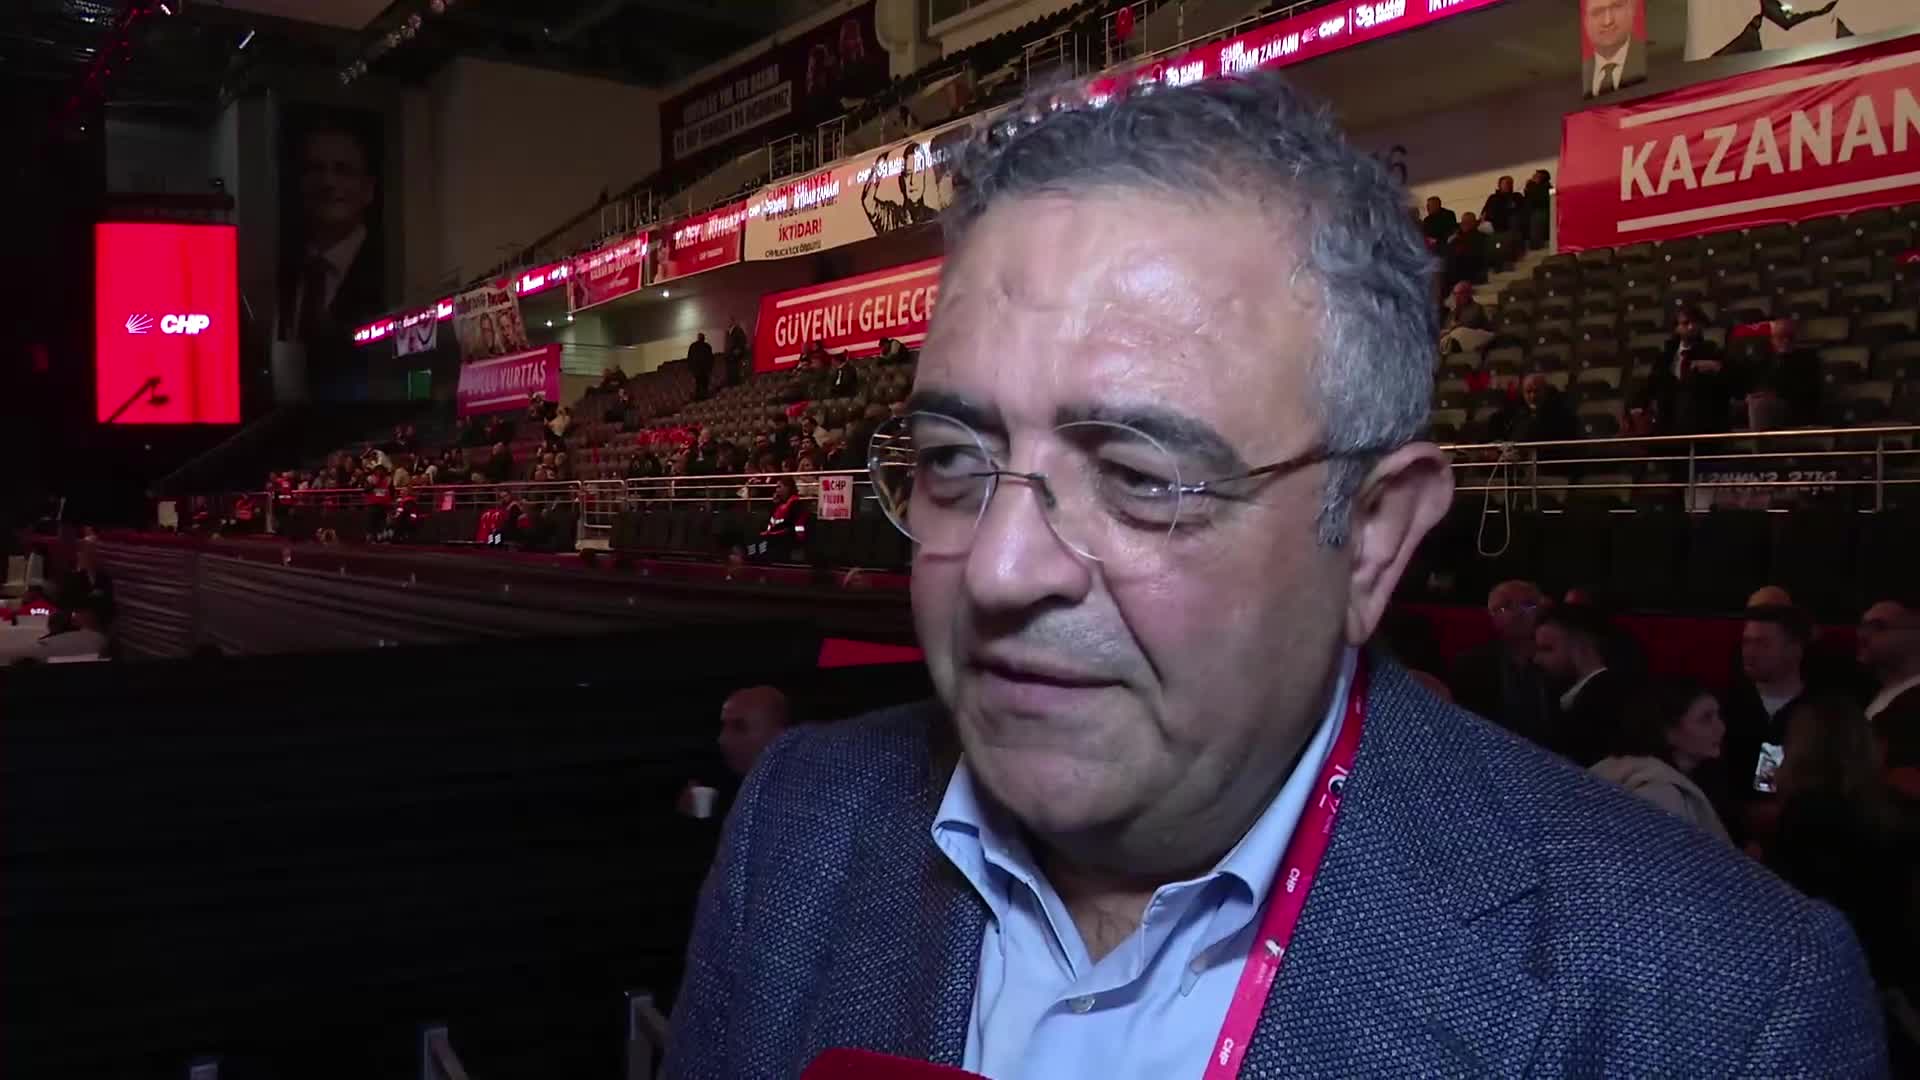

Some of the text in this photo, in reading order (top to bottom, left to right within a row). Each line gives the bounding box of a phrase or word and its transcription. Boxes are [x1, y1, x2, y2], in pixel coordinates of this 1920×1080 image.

[1260, 32, 1299, 64] ZAMANI
[1620, 87, 1920, 202] KAZANAN
[778, 217, 823, 242] İKTİDAR!
[160, 314, 210, 334] CHP
[775, 304, 852, 347] GÜVENLİ
[1285, 867, 1301, 894] CHP
